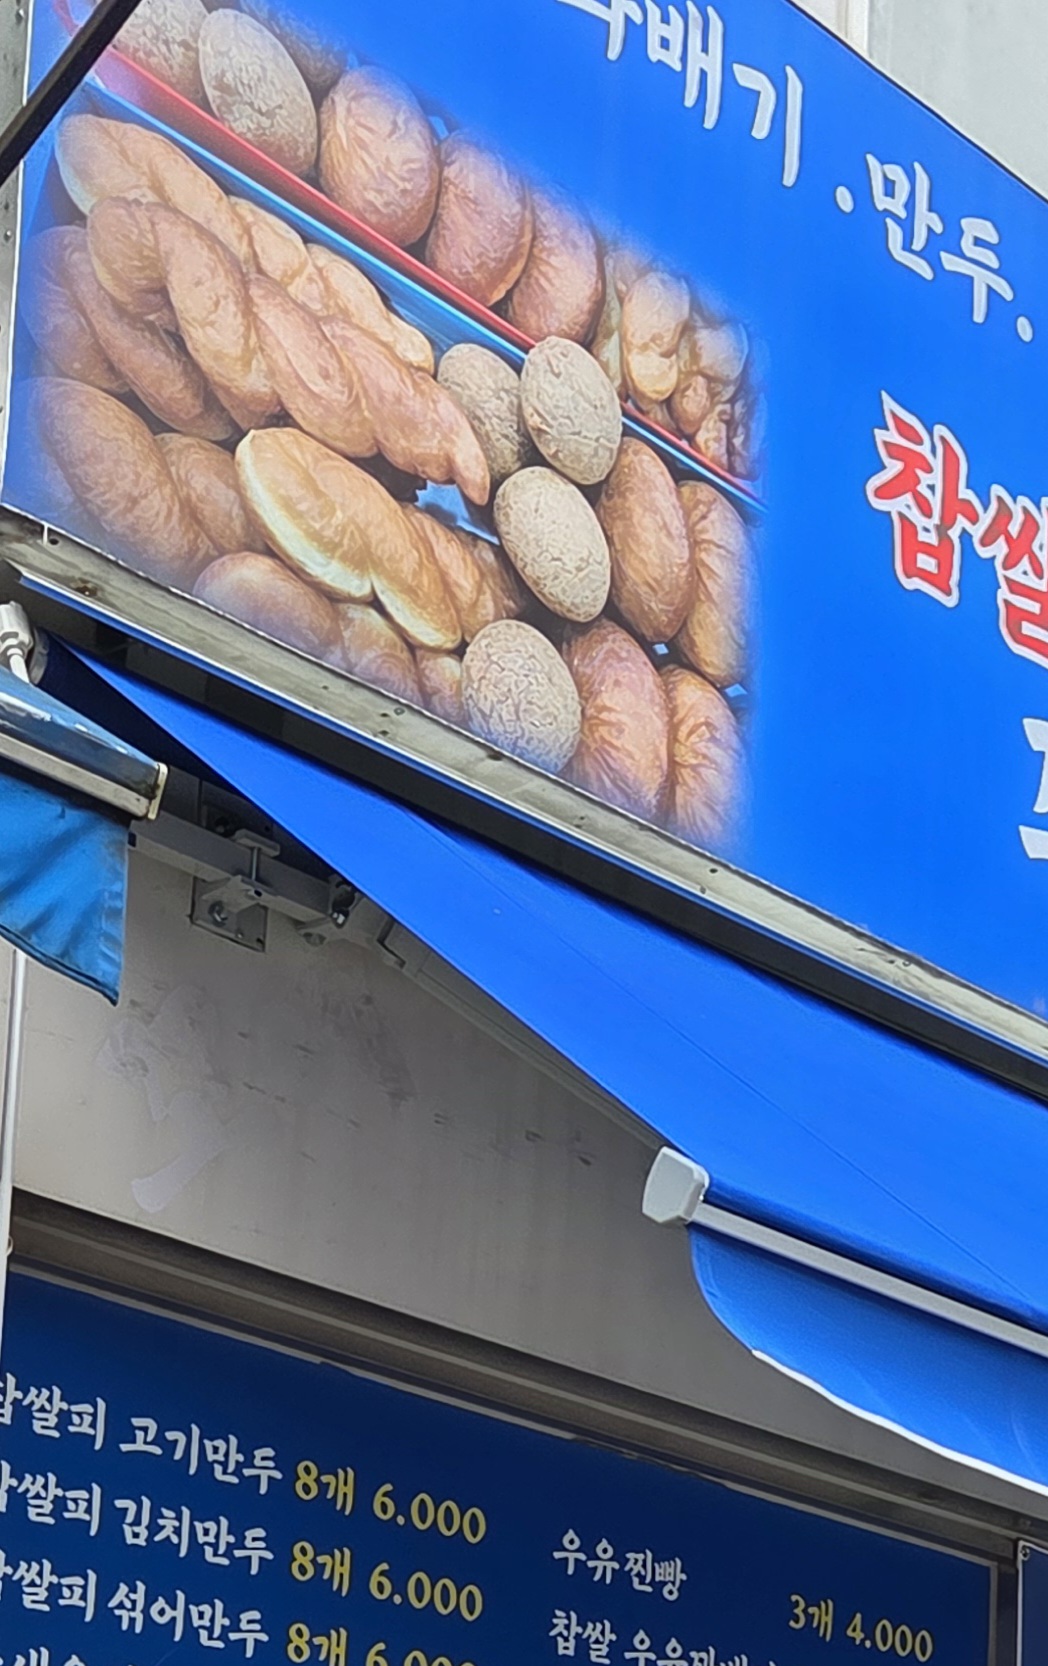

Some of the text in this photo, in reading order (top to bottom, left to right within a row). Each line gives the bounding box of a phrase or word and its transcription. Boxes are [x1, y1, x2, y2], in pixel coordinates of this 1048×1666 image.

[119, 1418, 283, 1495] 고기만두
[295, 1460, 355, 1516] 8개
[373, 1483, 486, 1544] 6.000
[114, 1496, 275, 1576] 김치만두
[291, 1541, 351, 1597] 8개
[369, 1562, 483, 1622] 6.000
[108, 1580, 270, 1658] 섞어만두
[548, 1609, 617, 1665] 찹쌀
[788, 1594, 834, 1642] 3개
[846, 1612, 933, 1663] 4.000
